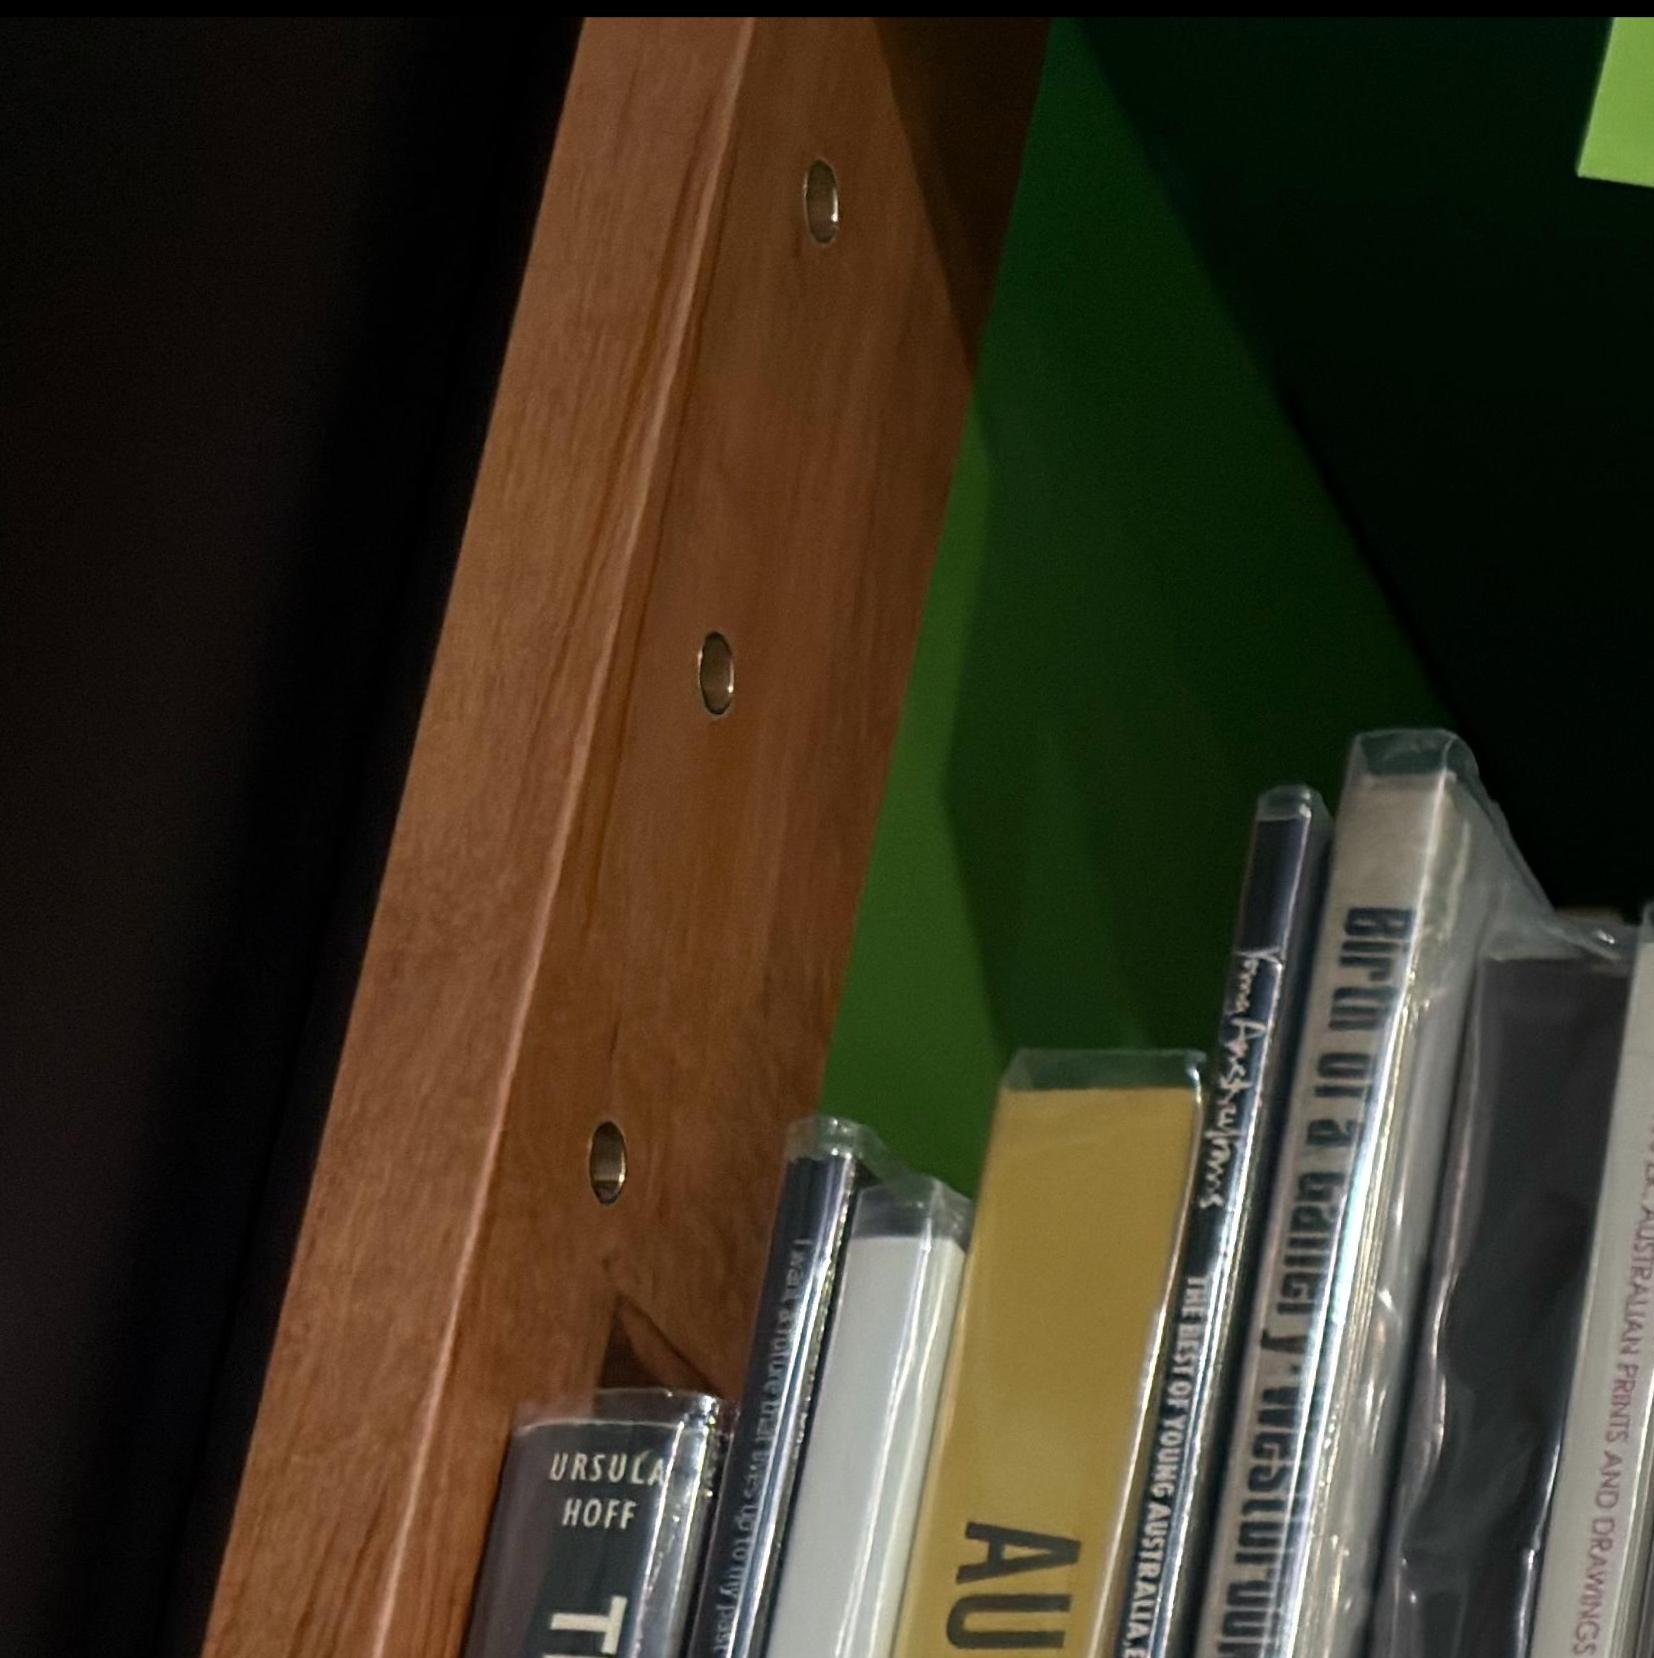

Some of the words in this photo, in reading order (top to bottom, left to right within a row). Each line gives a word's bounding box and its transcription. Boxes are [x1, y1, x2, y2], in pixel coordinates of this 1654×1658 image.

[1176, 1274, 1208, 1319] THE
[1600, 1365, 1638, 1444] PRINTS
[551, 1452, 670, 1485] URSULA
[1590, 1451, 1625, 1509] AND
[559, 1499, 641, 1531] HOFF
[1568, 1518, 1616, 1657] DRAWINGS
